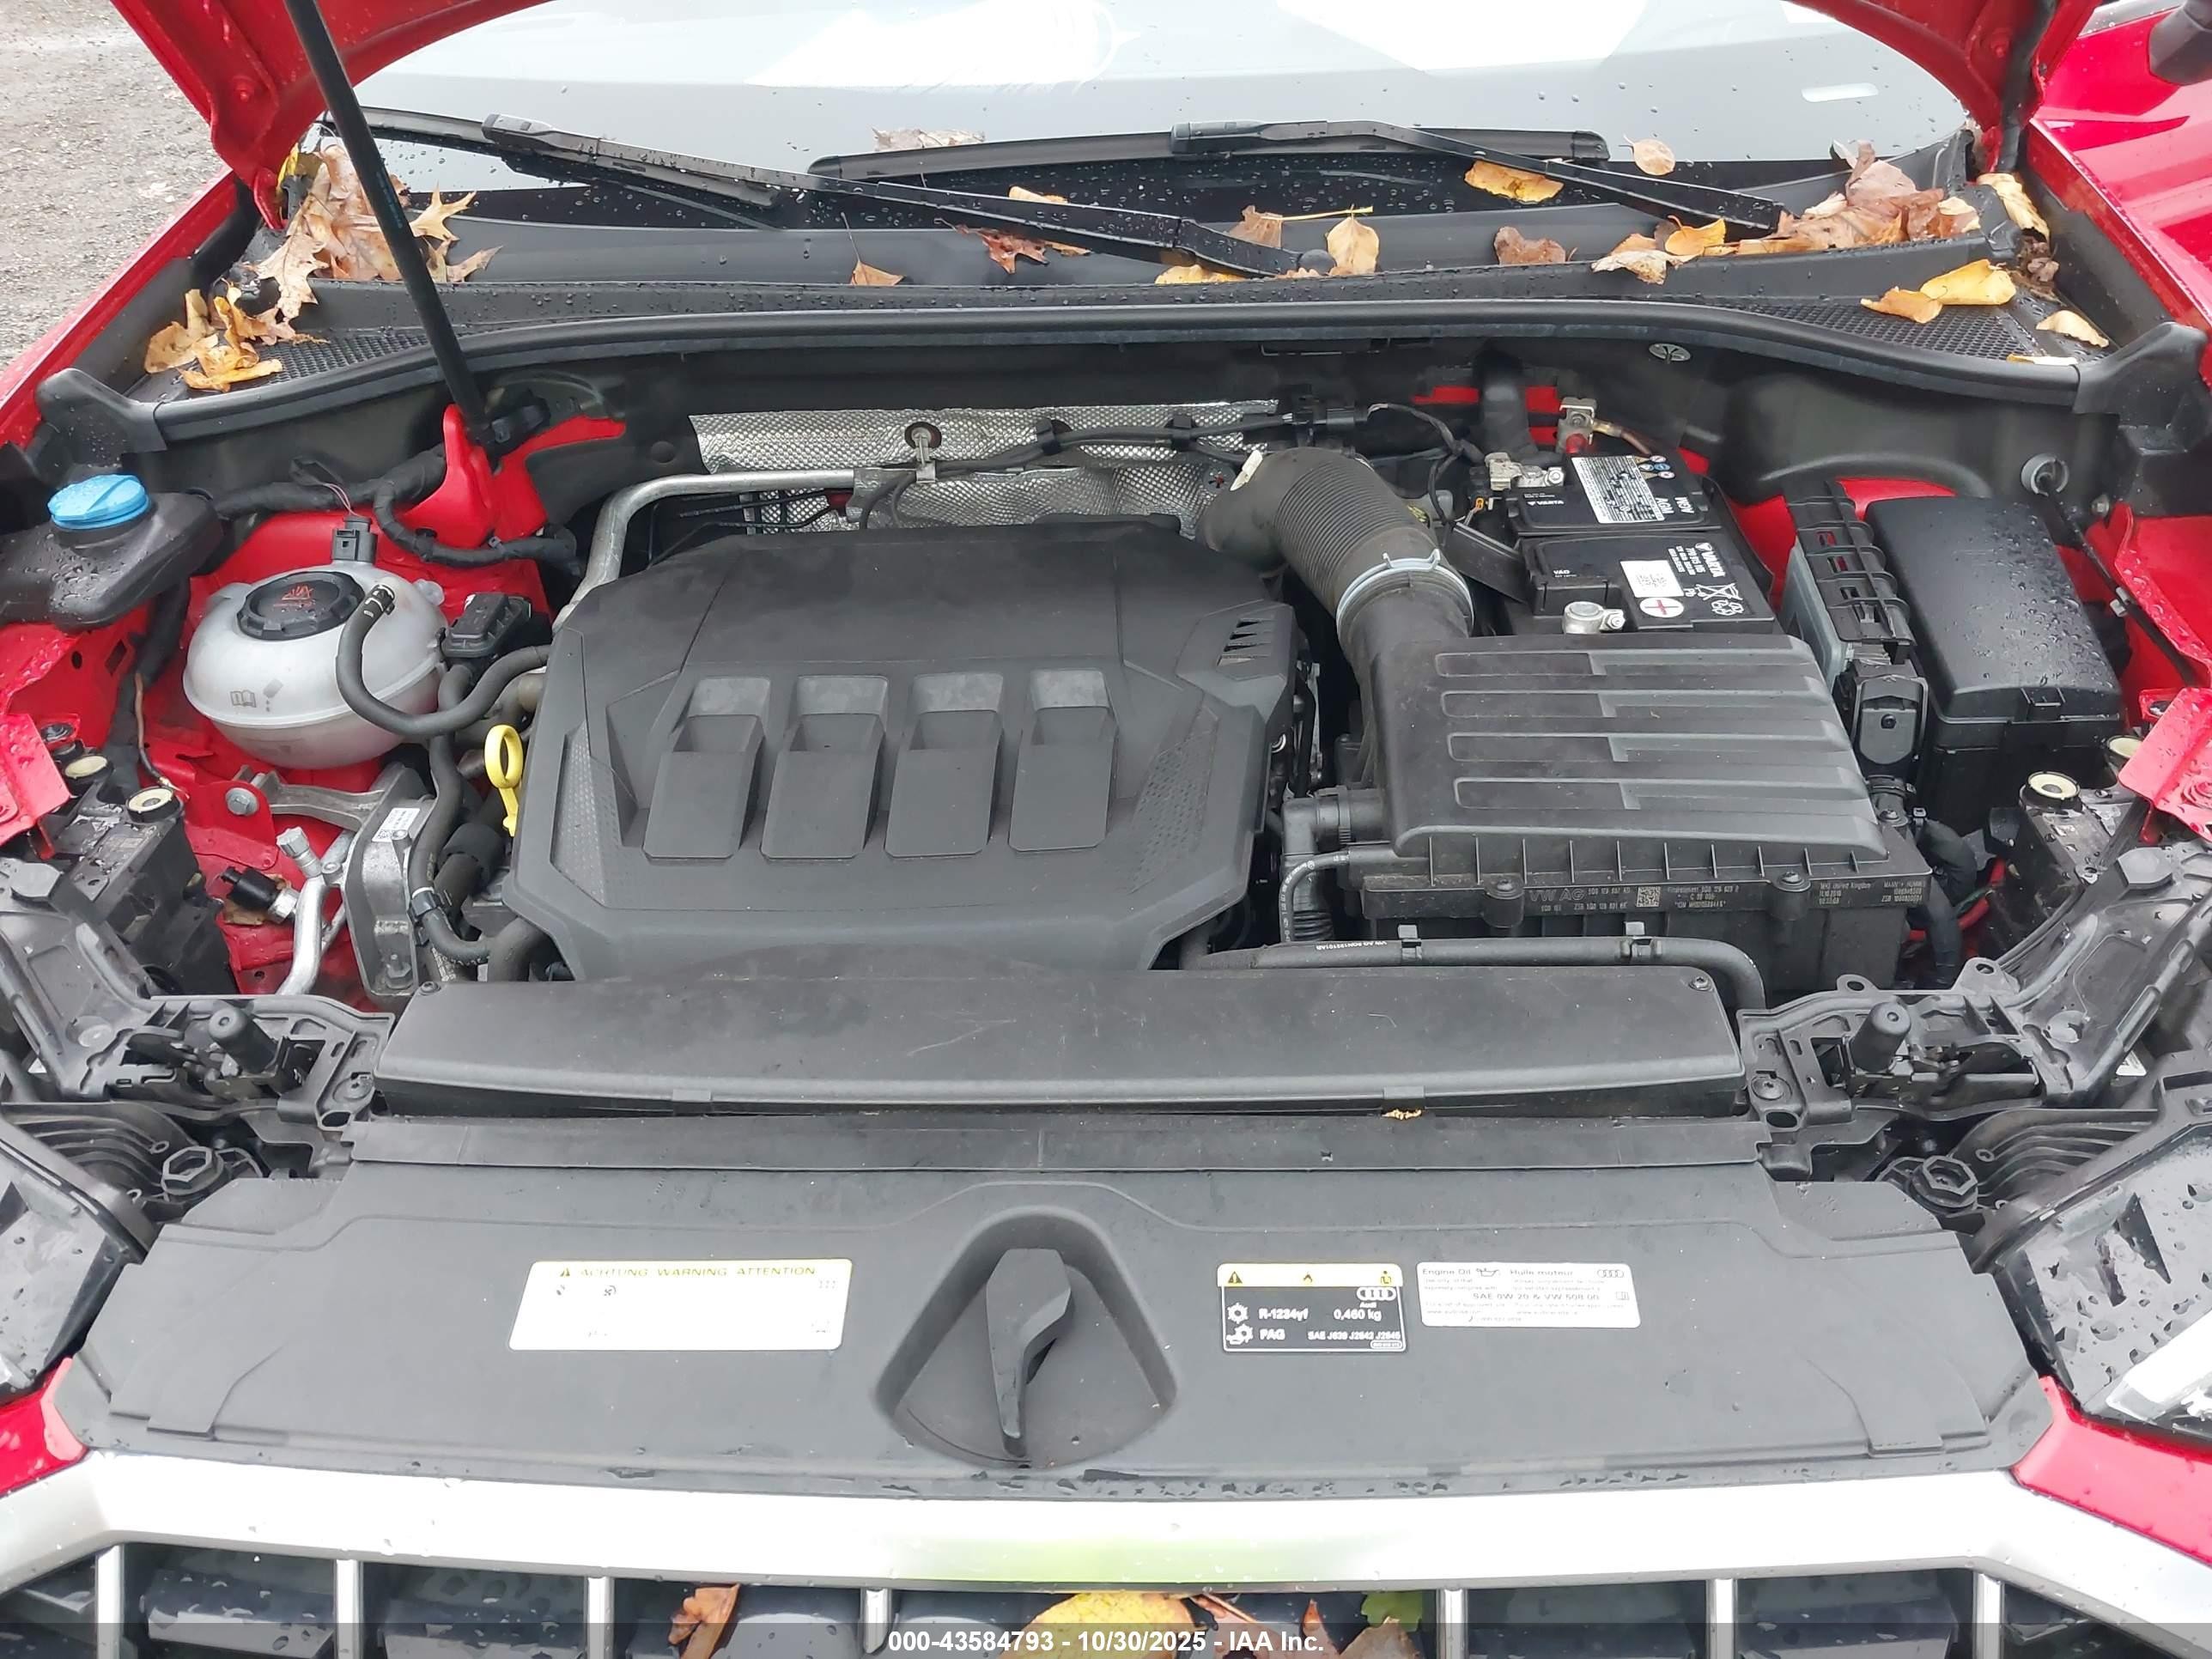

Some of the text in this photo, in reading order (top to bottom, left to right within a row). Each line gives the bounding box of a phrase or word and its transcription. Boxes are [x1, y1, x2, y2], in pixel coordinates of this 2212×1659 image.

[1656, 497, 1674, 514] AGM
[1675, 496, 1695, 514] AGM
[1701, 551, 1726, 577] VARTA
[1529, 888, 1585, 901] VW AG
[658, 1267, 727, 1276] WARNING
[737, 1267, 816, 1275] ATTENTION
[1258, 1308, 1309, 1321] R-1234yf
[1367, 1308, 1382, 1322] kg
[1260, 1329, 1285, 1340] PAG
[1308, 1331, 1326, 1340] SAE
[1328, 1331, 1347, 1340] J639
